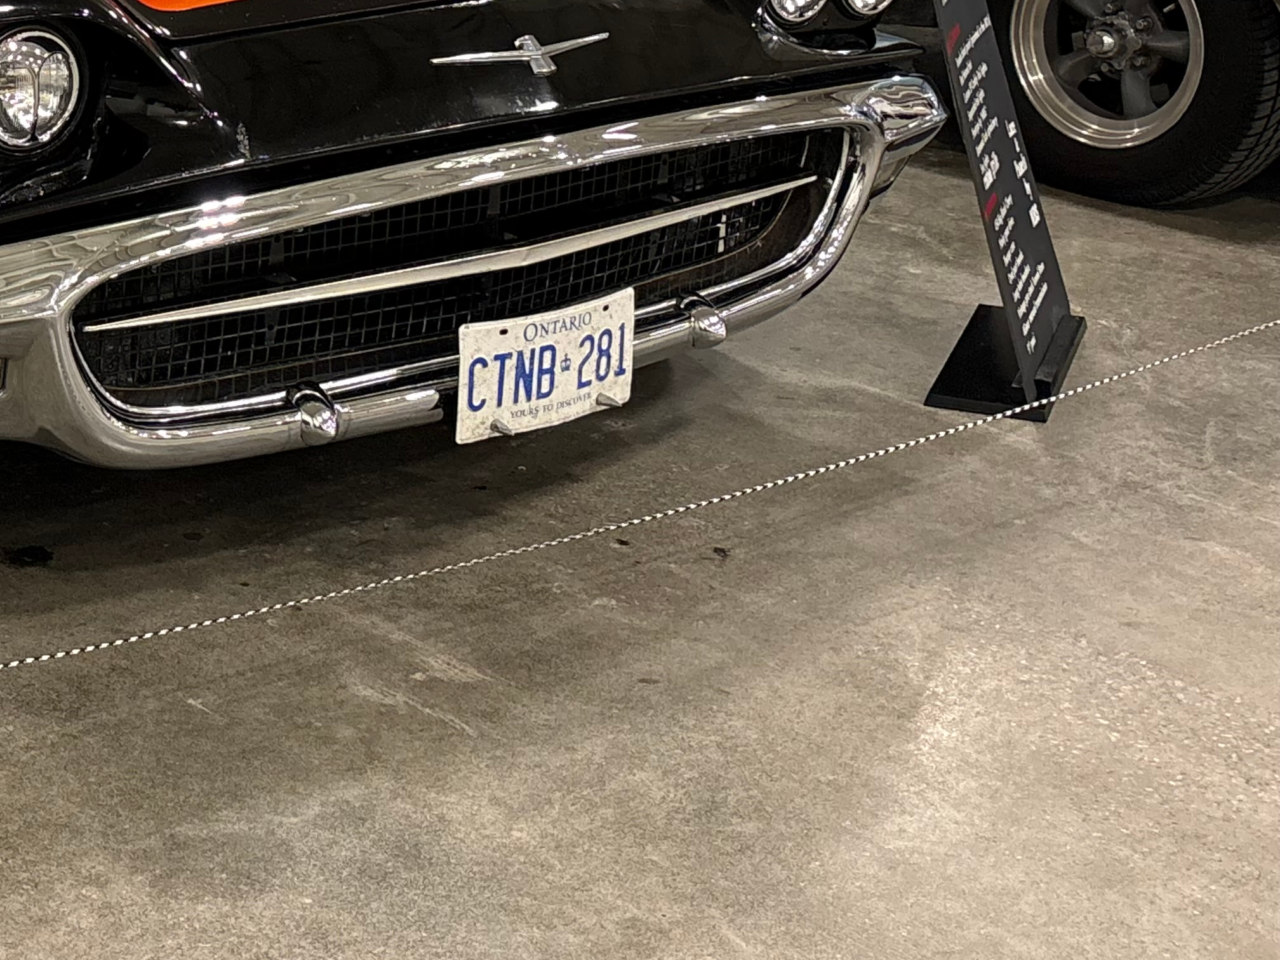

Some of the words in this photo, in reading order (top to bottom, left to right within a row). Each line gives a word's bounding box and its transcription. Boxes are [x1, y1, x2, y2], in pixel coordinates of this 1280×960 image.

[523, 311, 592, 342] ONTARIO
[467, 343, 557, 412] CTNB
[577, 322, 626, 390] 281
[510, 407, 540, 419] YOURS
[543, 403, 554, 413] TO
[556, 391, 592, 409] DISCOVER
